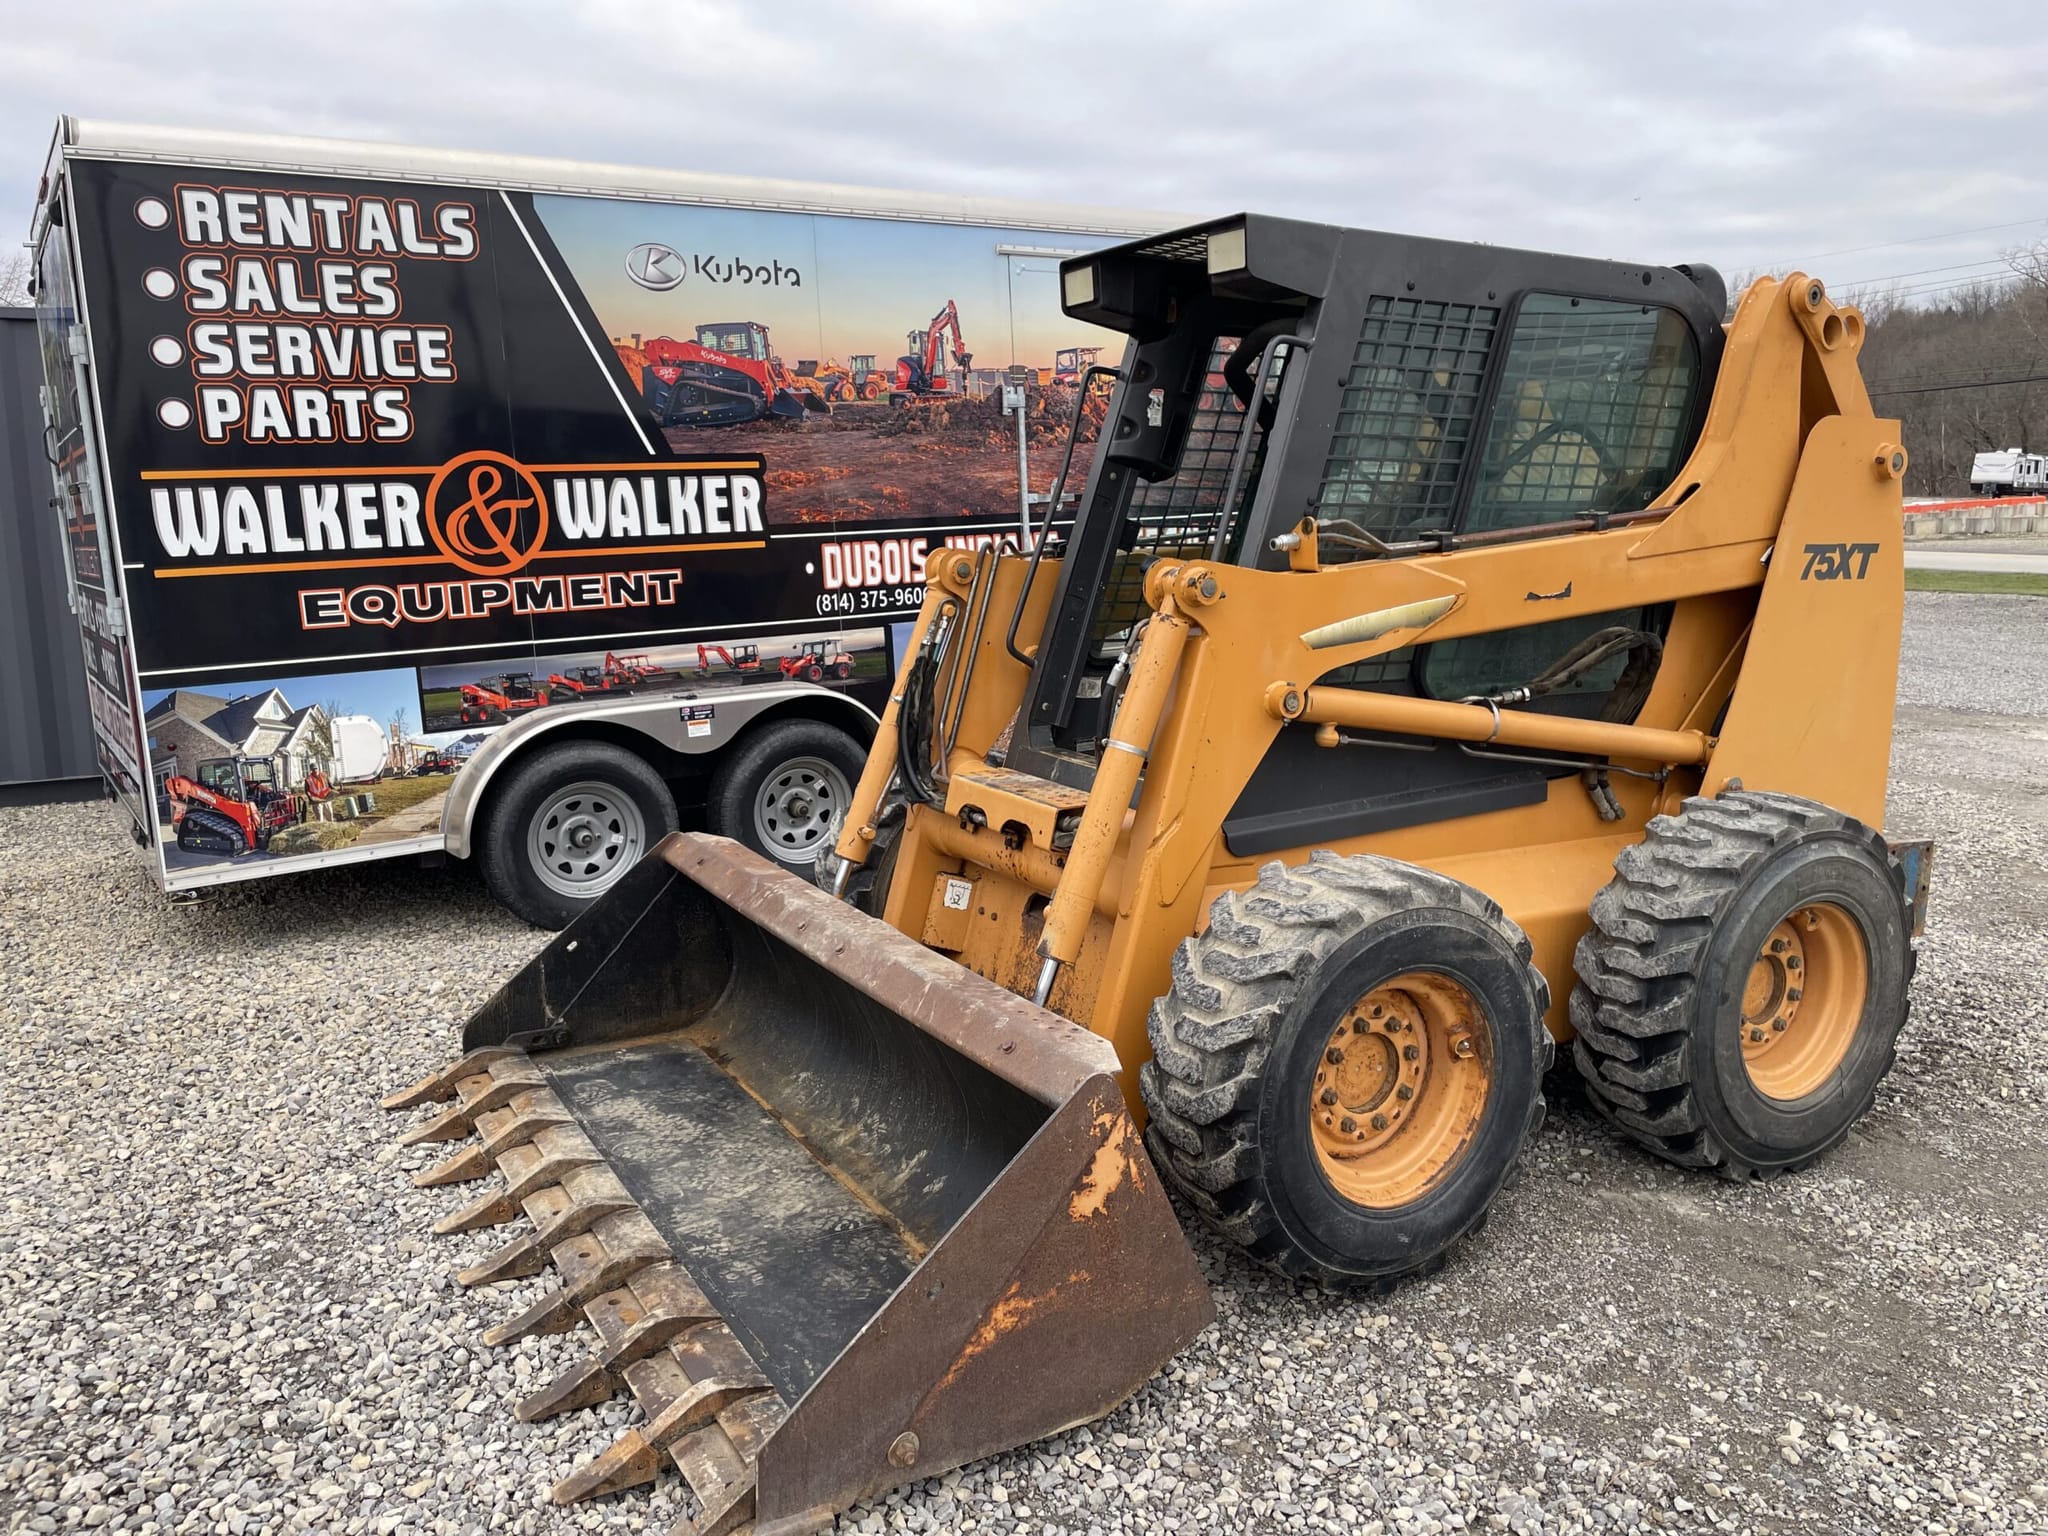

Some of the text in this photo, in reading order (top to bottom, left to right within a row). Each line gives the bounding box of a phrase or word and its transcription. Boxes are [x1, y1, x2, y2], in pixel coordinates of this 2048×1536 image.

[175, 184, 478, 260] RENTALS
[183, 254, 401, 320] SALES
[693, 253, 801, 288] Kubota
[188, 320, 456, 382] SERVICE
[196, 384, 414, 444] PARTS
[150, 482, 425, 557] WALKER
[443, 462, 536, 570] &
[553, 474, 764, 540] WALKER
[821, 537, 929, 590] DUBOIS
[1800, 543, 1880, 581] 75XT
[298, 569, 683, 629] EQUIPMENT
[816, 592, 855, 616] (814)
